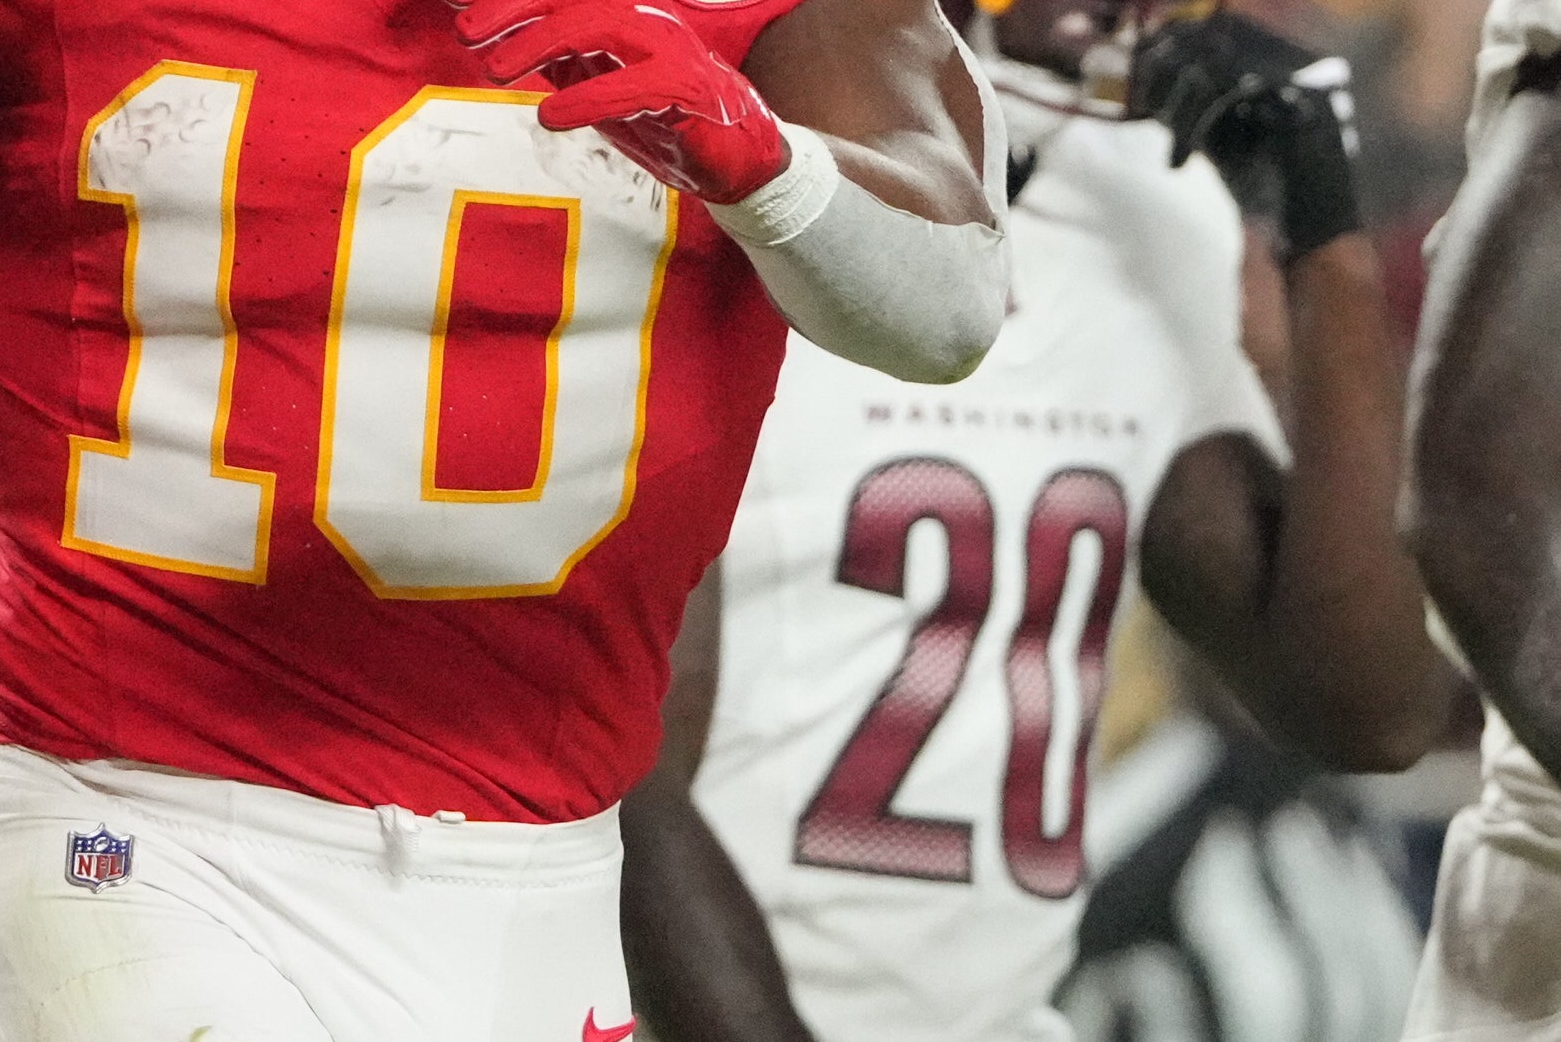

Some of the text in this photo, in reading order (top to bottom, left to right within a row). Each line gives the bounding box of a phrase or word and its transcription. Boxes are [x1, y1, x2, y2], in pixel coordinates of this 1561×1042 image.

[60, 58, 680, 601] 10
[76, 853, 123, 880] NFL
[790, 454, 1128, 900] 20
